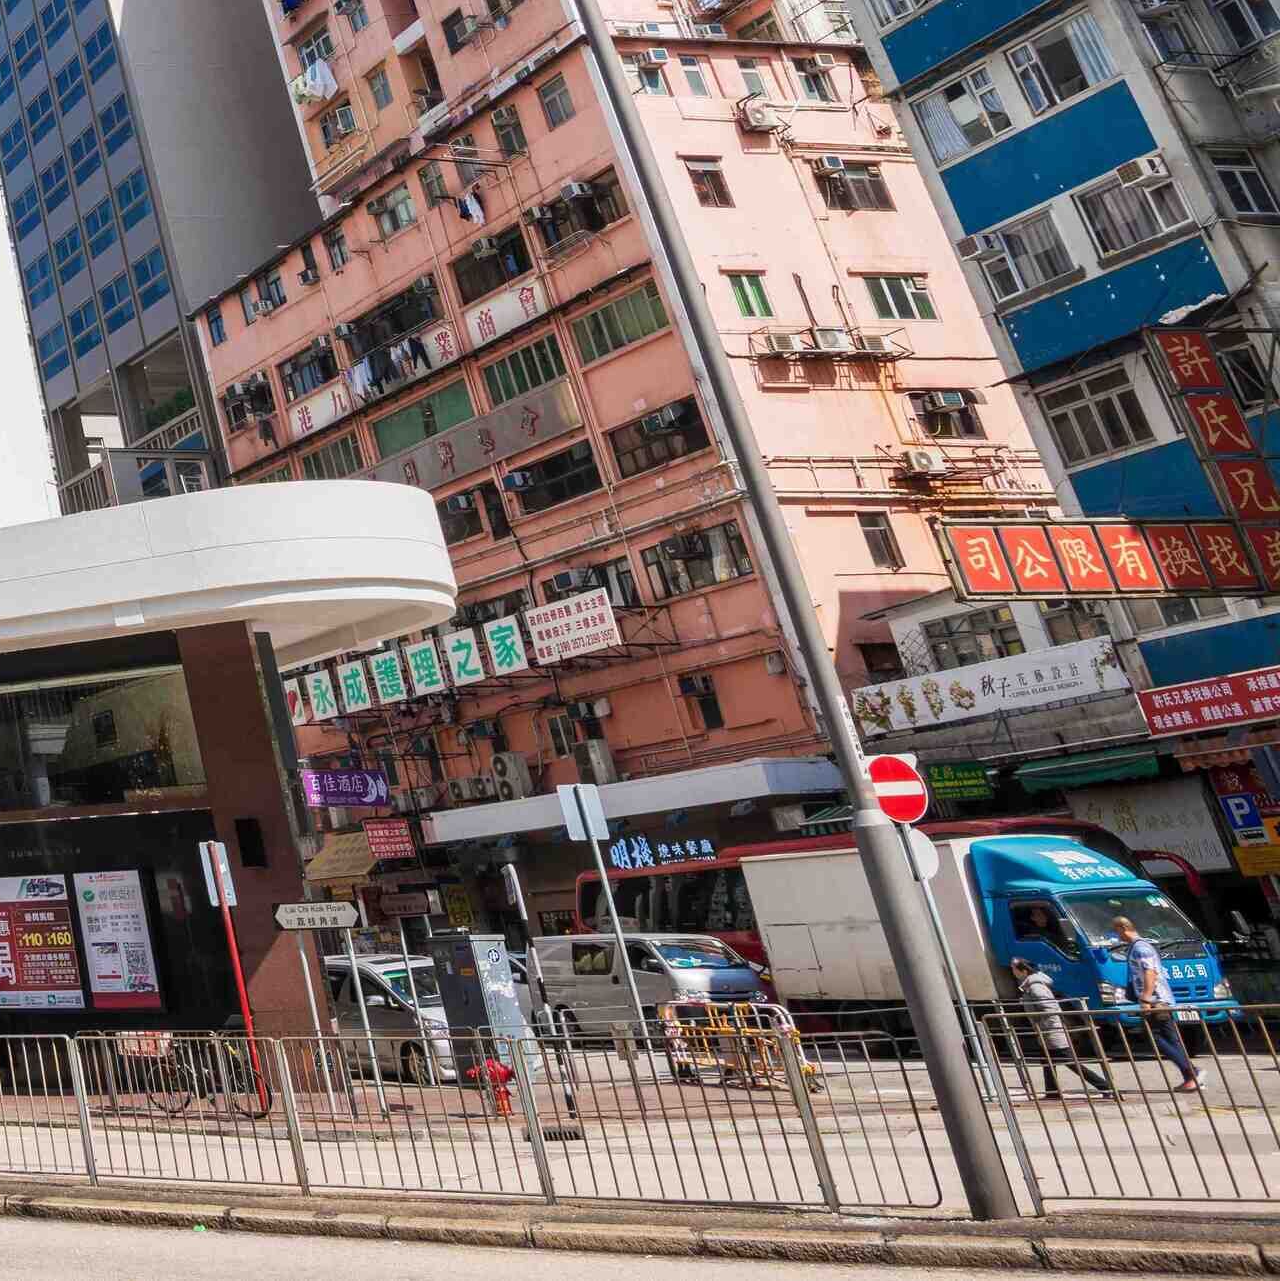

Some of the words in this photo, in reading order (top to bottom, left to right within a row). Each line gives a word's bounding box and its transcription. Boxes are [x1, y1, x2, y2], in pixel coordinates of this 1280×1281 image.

[312, 624, 522, 715] 永成護理之家
[296, 905, 309, 913] Chi
[310, 905, 325, 913] Kok
[326, 904, 346, 912] Road
